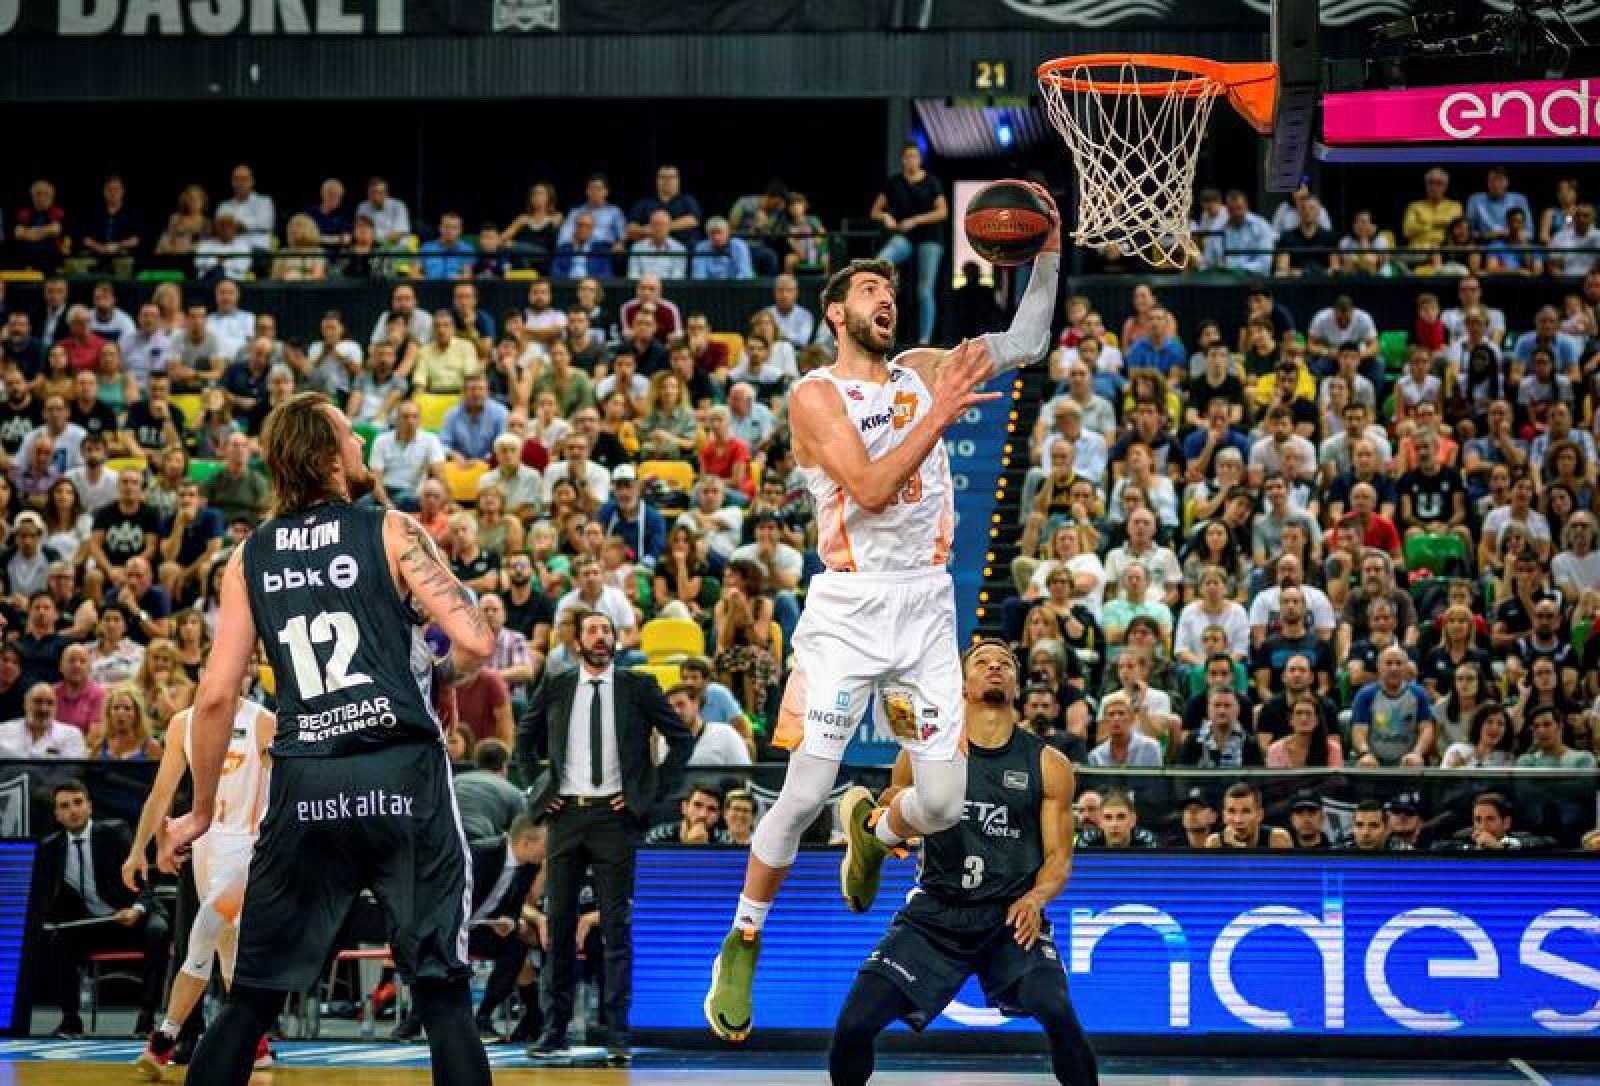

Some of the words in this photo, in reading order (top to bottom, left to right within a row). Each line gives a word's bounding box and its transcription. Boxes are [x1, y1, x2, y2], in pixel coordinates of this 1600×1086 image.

[976, 62, 1006, 88] 21
[1438, 79, 1600, 139] end
[262, 567, 324, 593] bbk
[277, 610, 375, 701] 12
[961, 855, 985, 889] 3
[942, 868, 1600, 1031] ndes
